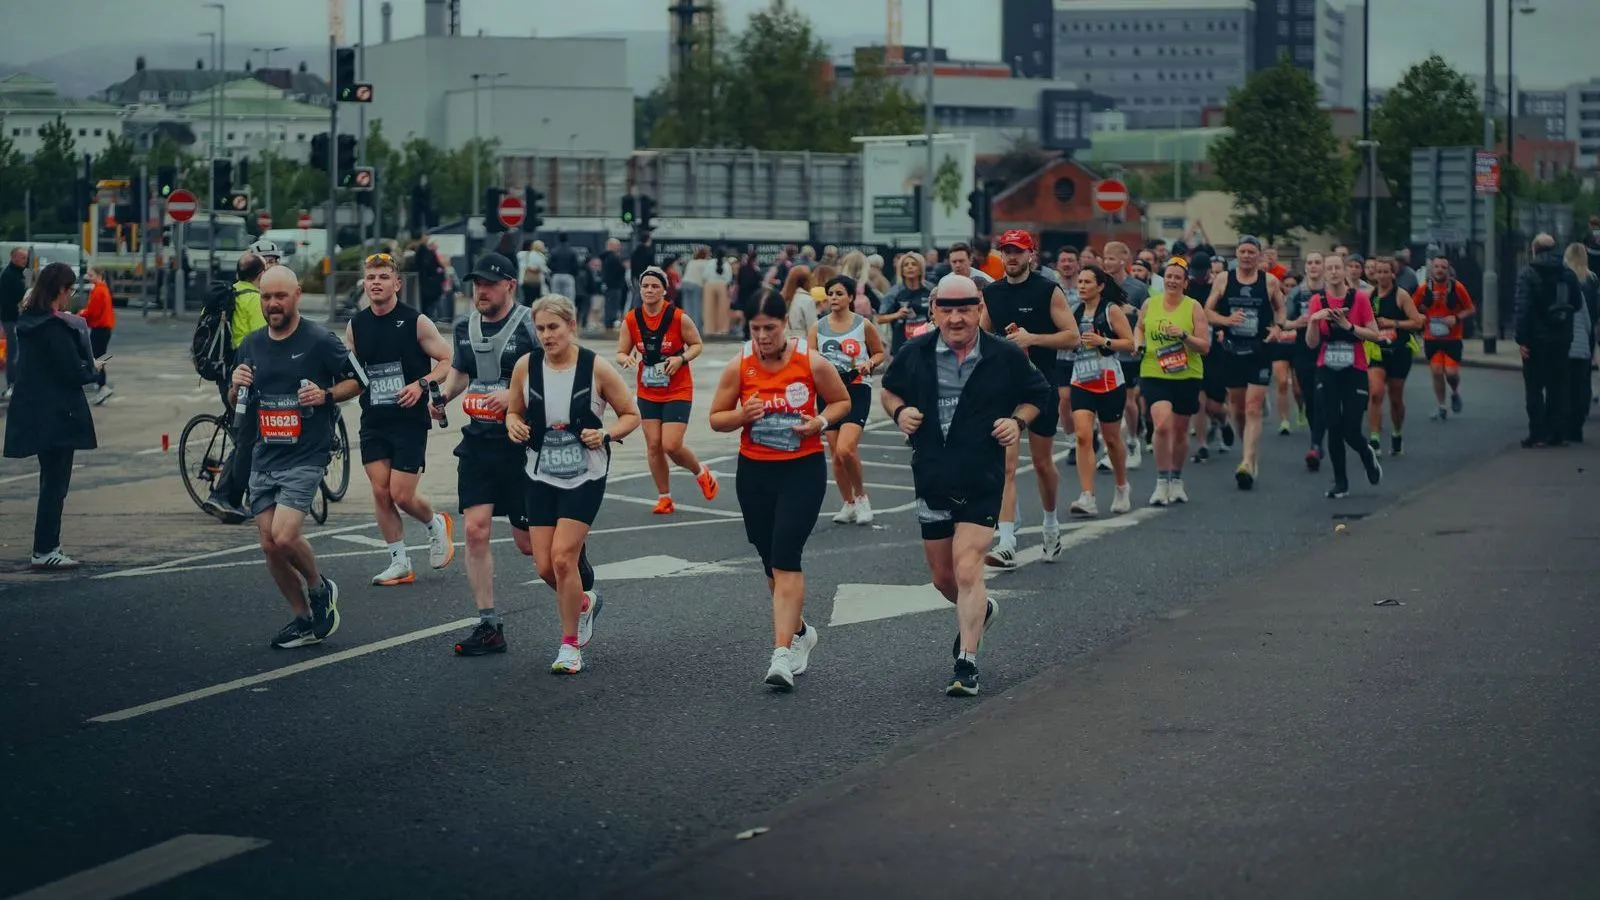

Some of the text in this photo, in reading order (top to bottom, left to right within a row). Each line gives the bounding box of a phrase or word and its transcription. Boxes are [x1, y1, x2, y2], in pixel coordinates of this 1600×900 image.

[846, 344, 855, 354] R
[371, 377, 403, 395] 3840
[260, 415, 299, 427] 11562B
